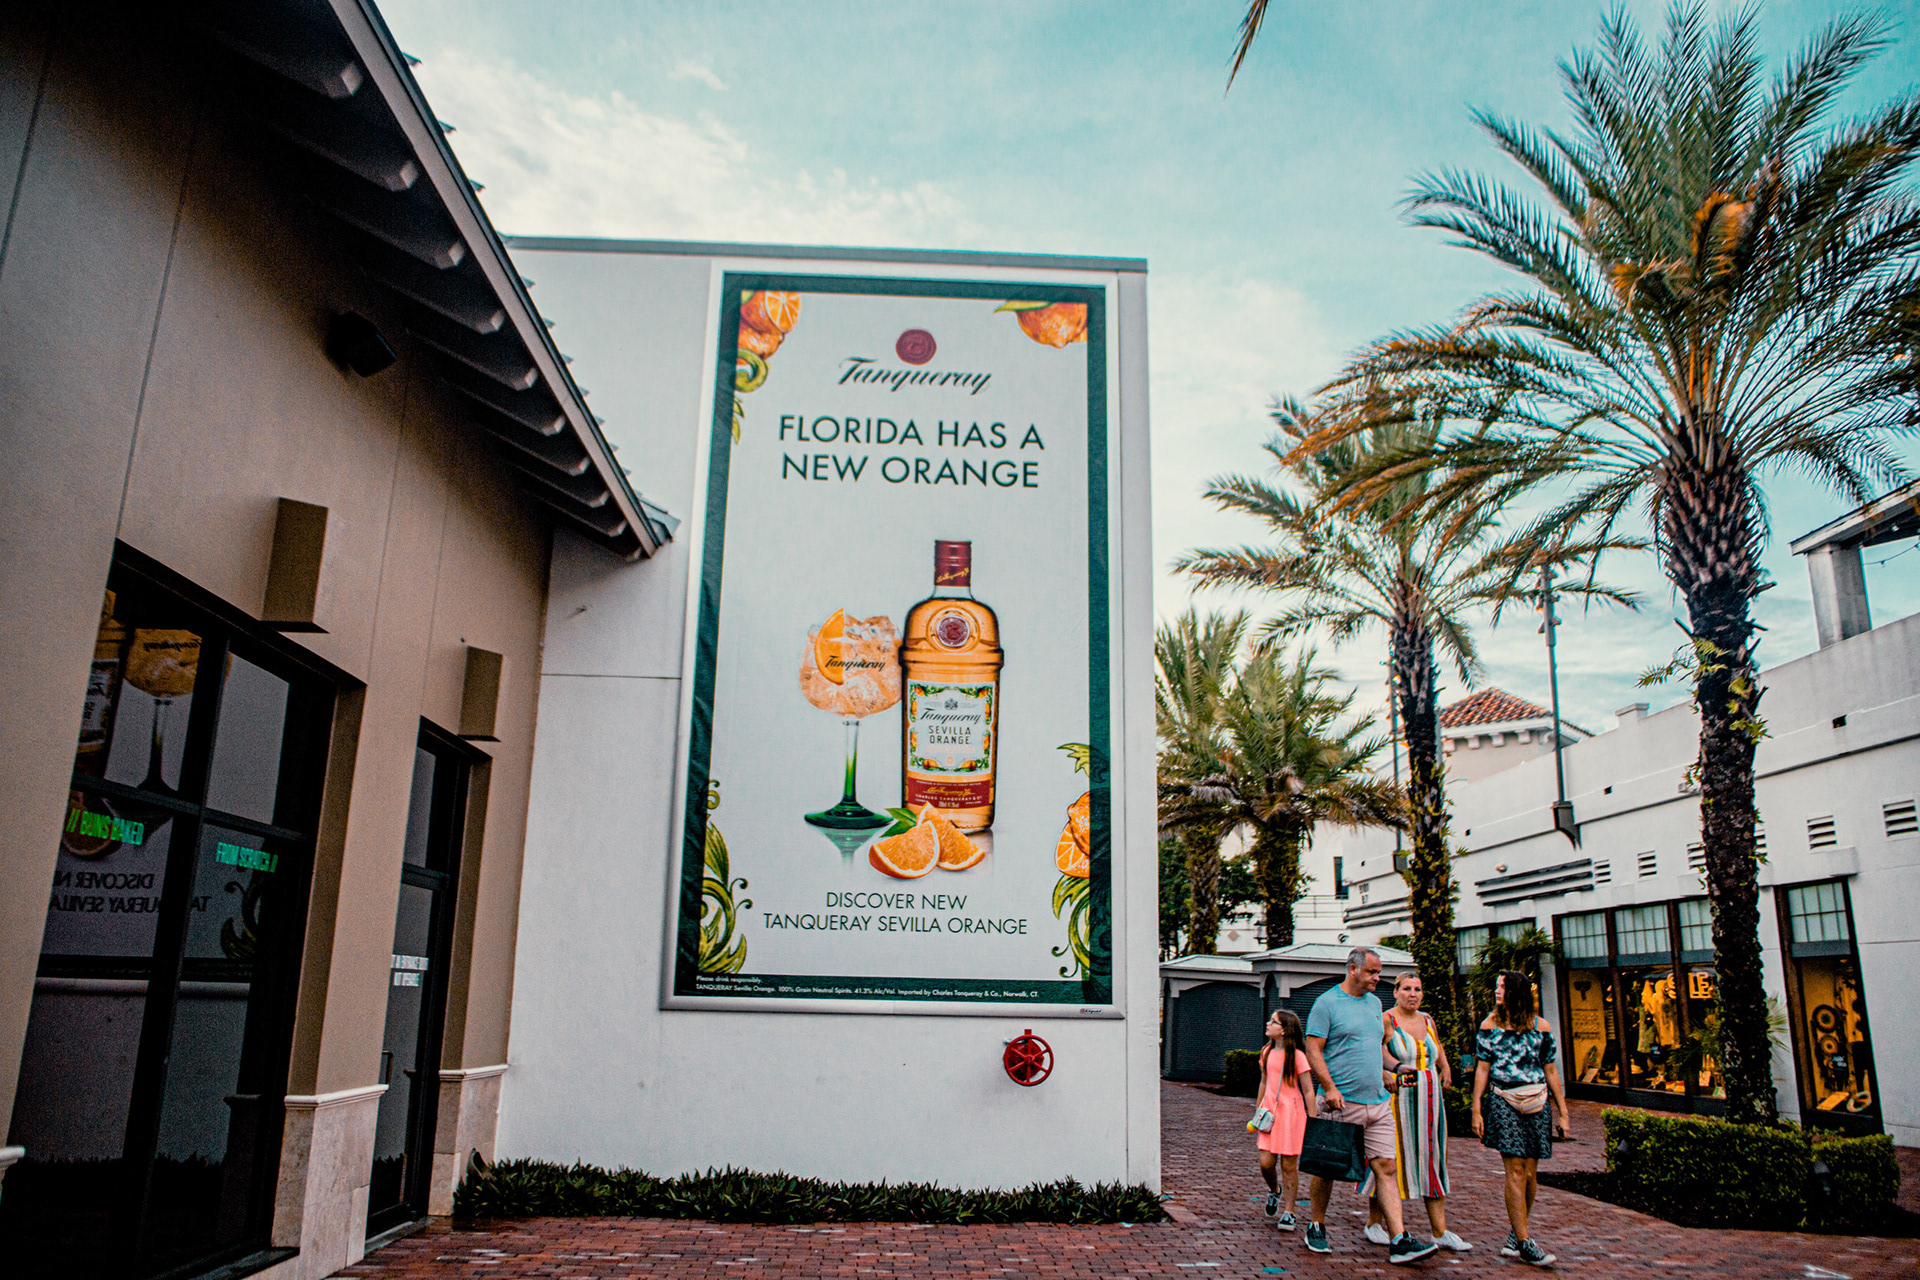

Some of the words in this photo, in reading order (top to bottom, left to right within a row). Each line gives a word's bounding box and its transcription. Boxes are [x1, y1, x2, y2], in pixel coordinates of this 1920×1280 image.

[838, 357, 993, 395] Tanqueray
[779, 415, 923, 447] FLORIDA
[938, 420, 1007, 449] HAS
[1019, 424, 1045, 450] A
[782, 453, 869, 482] NEW
[881, 457, 1039, 488] ORANGE
[824, 655, 886, 671] Tanqueray
[920, 707, 981, 725] Tanqueray
[928, 725, 972, 735] SEVILLA
[929, 735, 970, 745] ORANGE
[826, 892, 915, 909] DISCOVER
[921, 894, 968, 910] NEW
[763, 913, 872, 931] TANQUERAY
[877, 915, 942, 932] SEVILLA
[948, 917, 1028, 935] ORANGE
